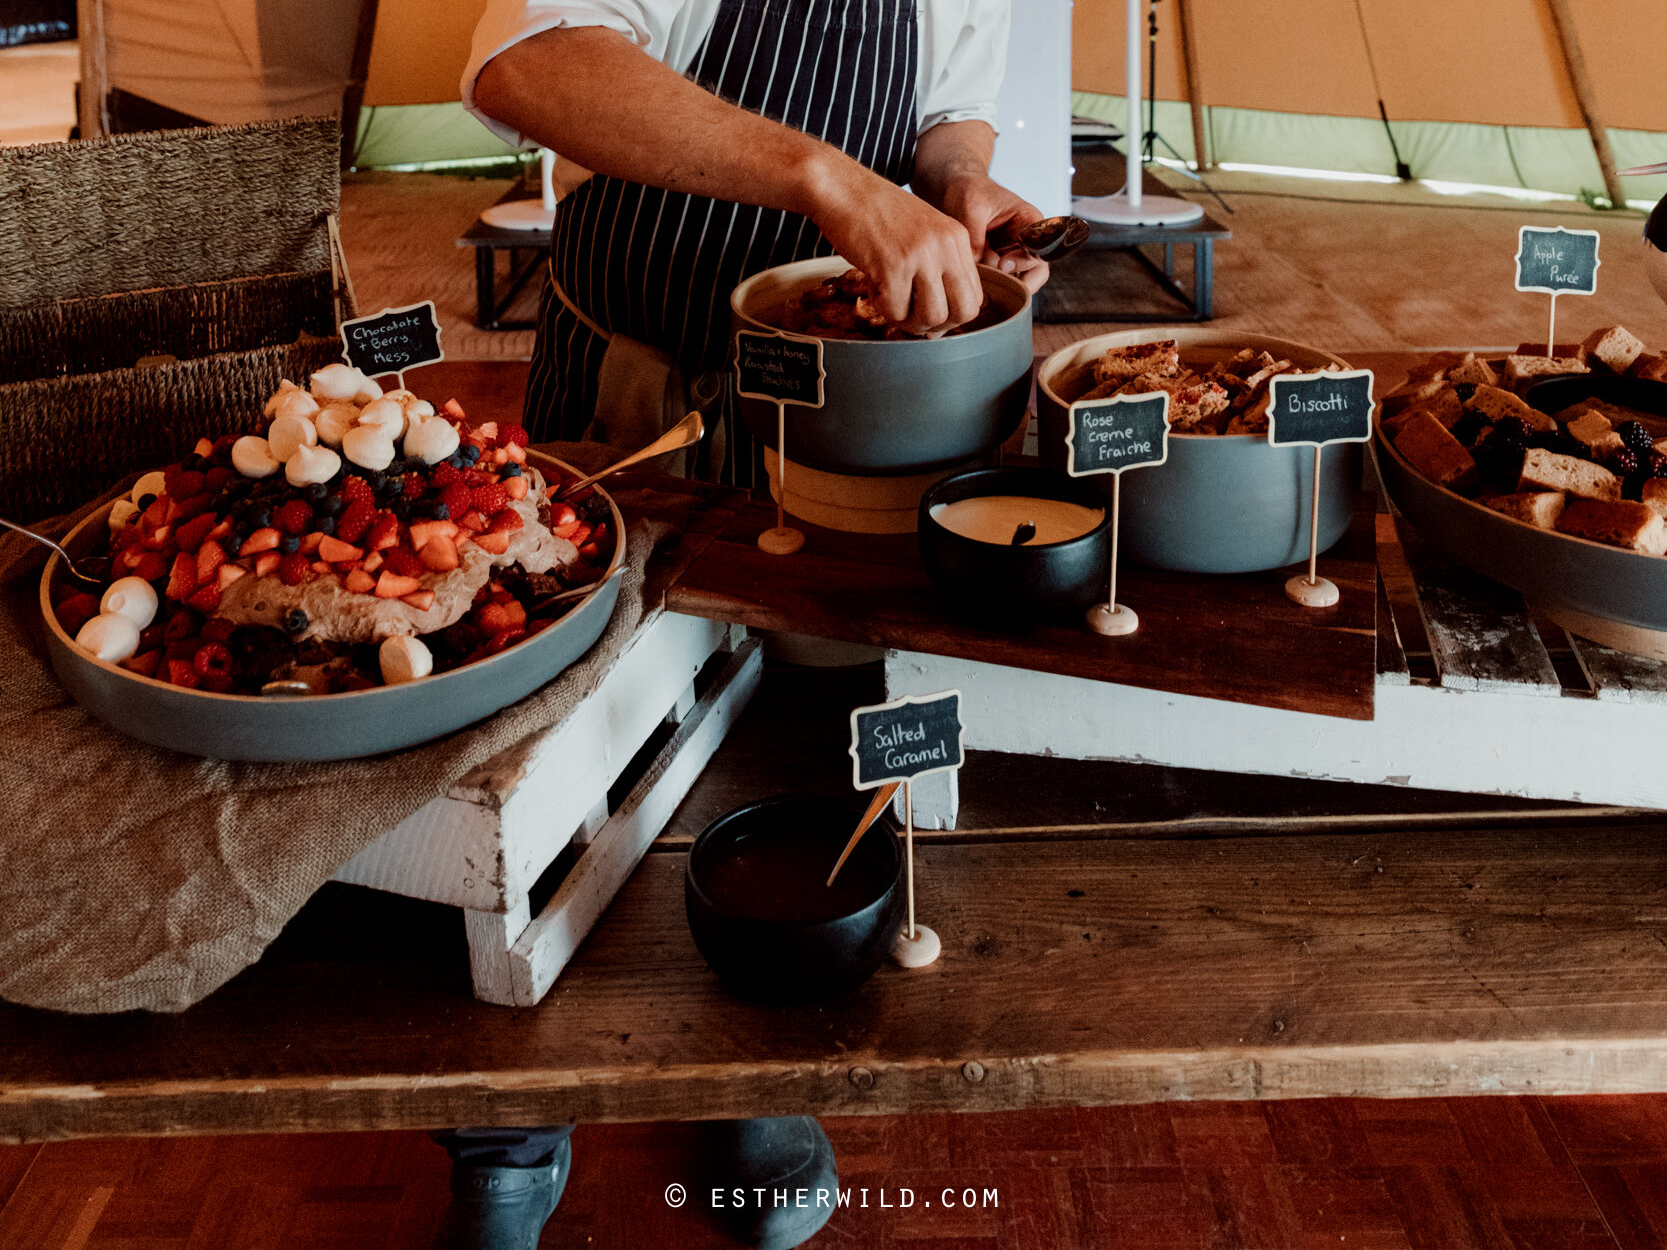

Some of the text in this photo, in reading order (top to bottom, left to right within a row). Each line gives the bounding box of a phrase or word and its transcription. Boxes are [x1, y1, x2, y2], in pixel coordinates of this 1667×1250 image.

[1534, 244, 1564, 265] Apple
[353, 316, 420, 339] Chocolate
[371, 334, 409, 349] Berry
[374, 351, 410, 363] Mess
[1288, 392, 1348, 413] Biscotti
[1082, 412, 1113, 428] Rose
[1099, 441, 1151, 460] Fraiche
[873, 722, 926, 749] Salted
[885, 739, 947, 769] Caramel
